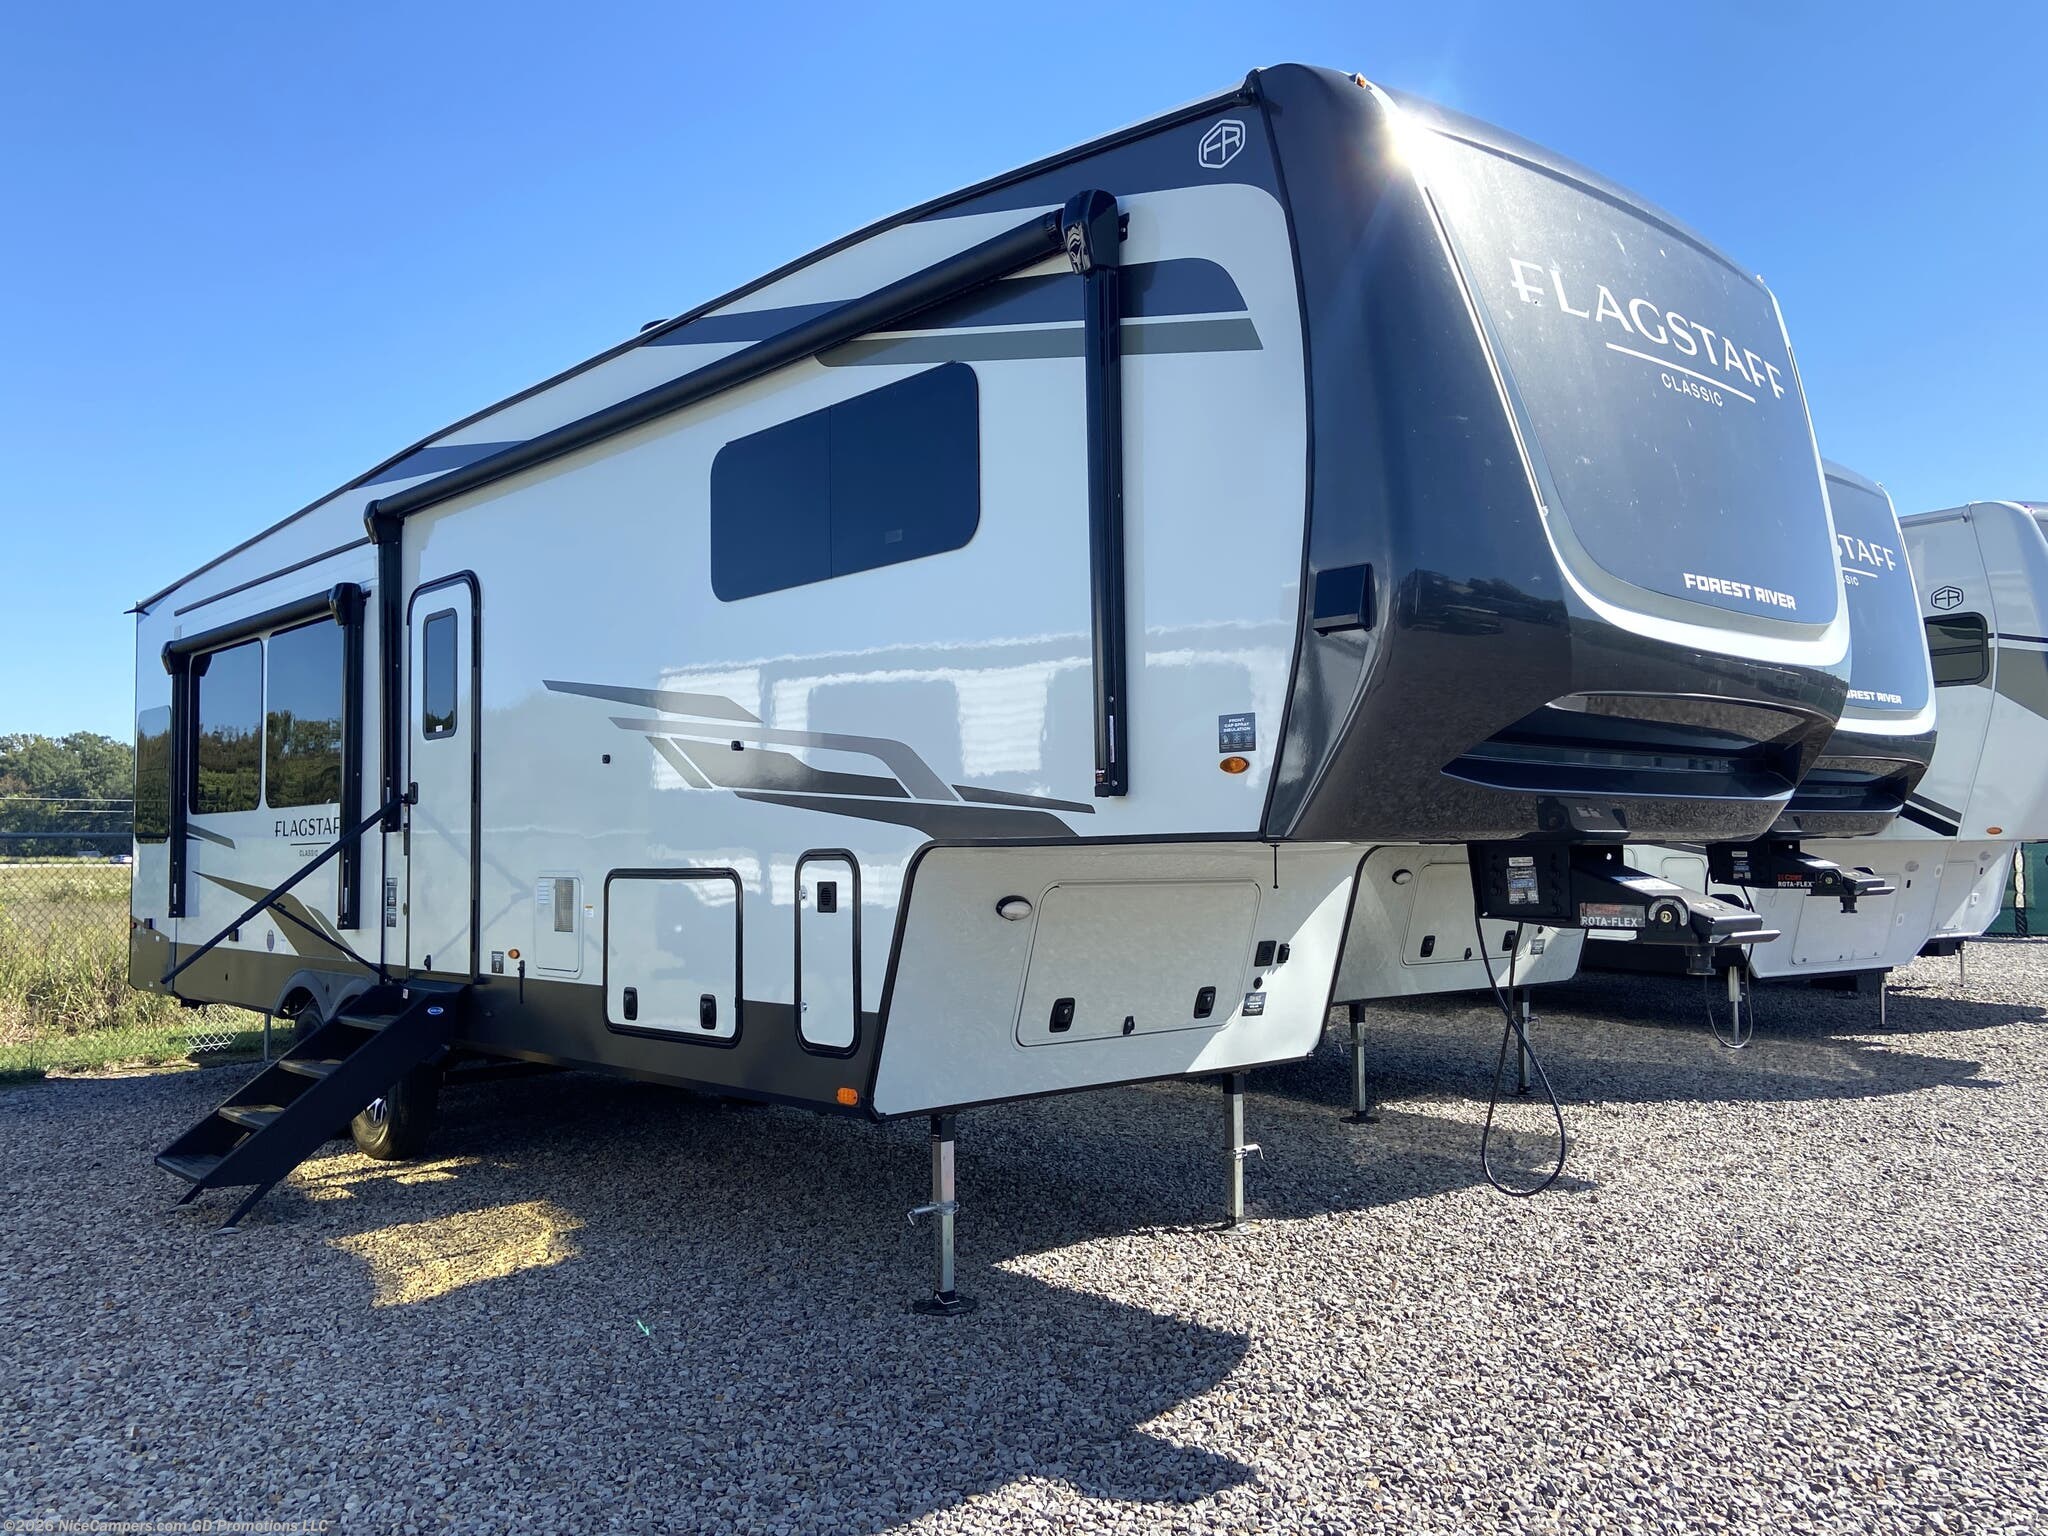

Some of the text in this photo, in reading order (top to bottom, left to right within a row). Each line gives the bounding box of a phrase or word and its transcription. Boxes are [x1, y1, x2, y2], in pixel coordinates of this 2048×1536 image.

[1509, 258, 1785, 400] FLAGSTAFF
[1661, 372, 1723, 407] CLASSIC
[1837, 533, 1896, 572] TAFF
[1683, 572, 1797, 611] FOREST RIVER
[1842, 574, 1860, 587] SIC
[1876, 691, 1903, 705] RIVER
[299, 849, 319, 858] CLASSIC
[1581, 915, 1639, 927] ROTA-FLEX
